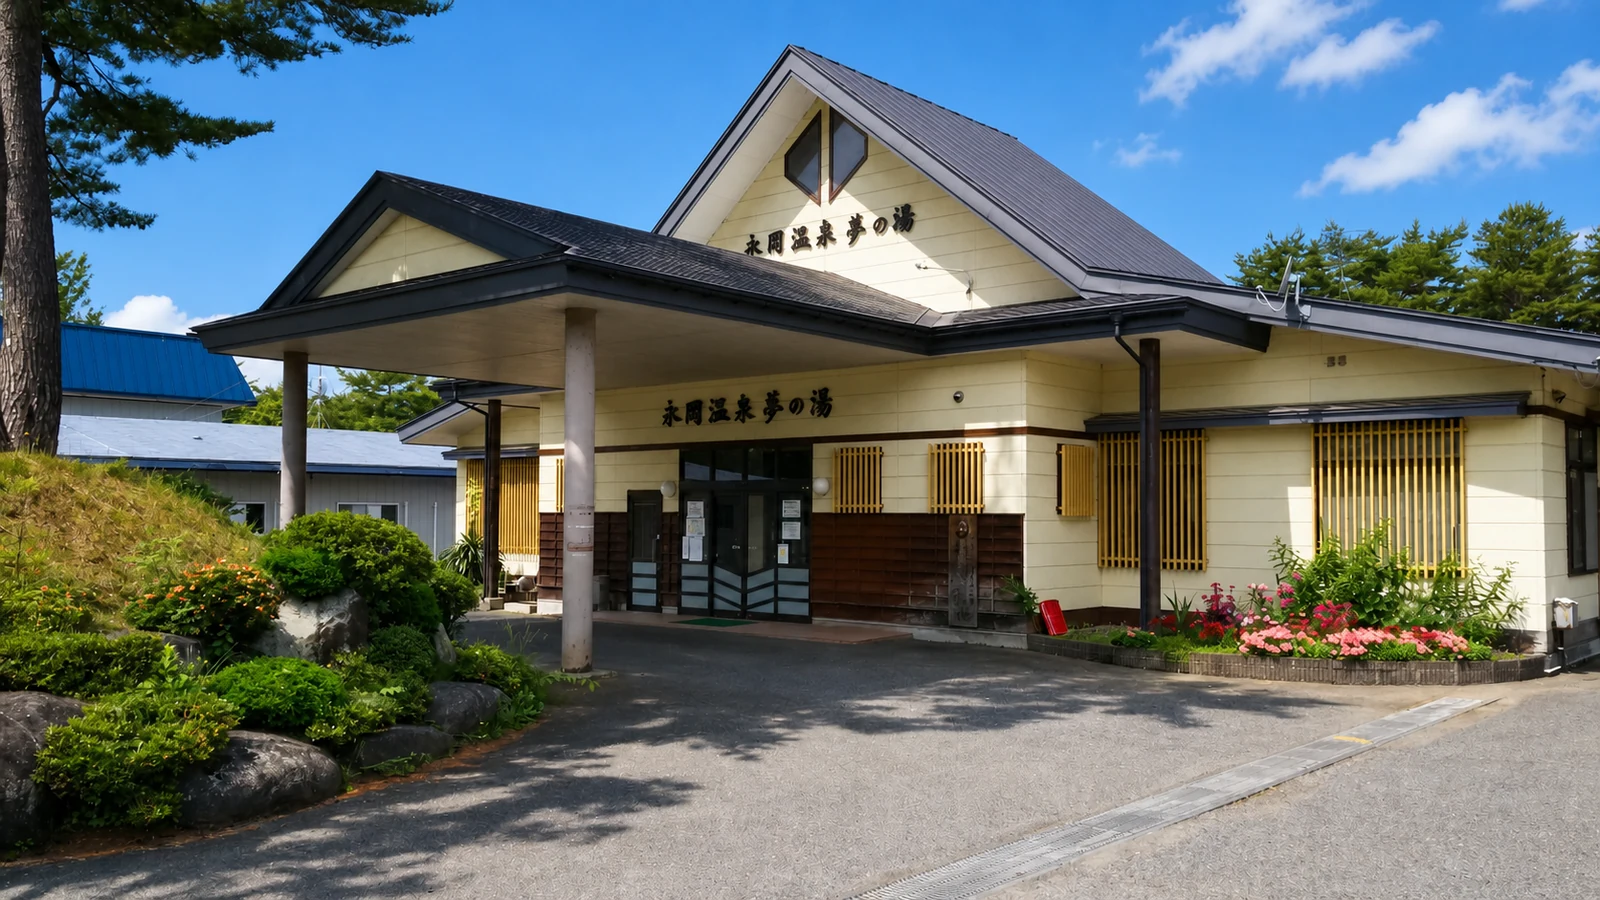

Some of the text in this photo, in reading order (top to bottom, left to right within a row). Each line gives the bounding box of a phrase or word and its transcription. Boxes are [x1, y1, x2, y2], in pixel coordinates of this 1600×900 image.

[744, 203, 916, 256] 永岡温泉夢の湯
[662, 387, 833, 427] 永岡温泉夢の湯
